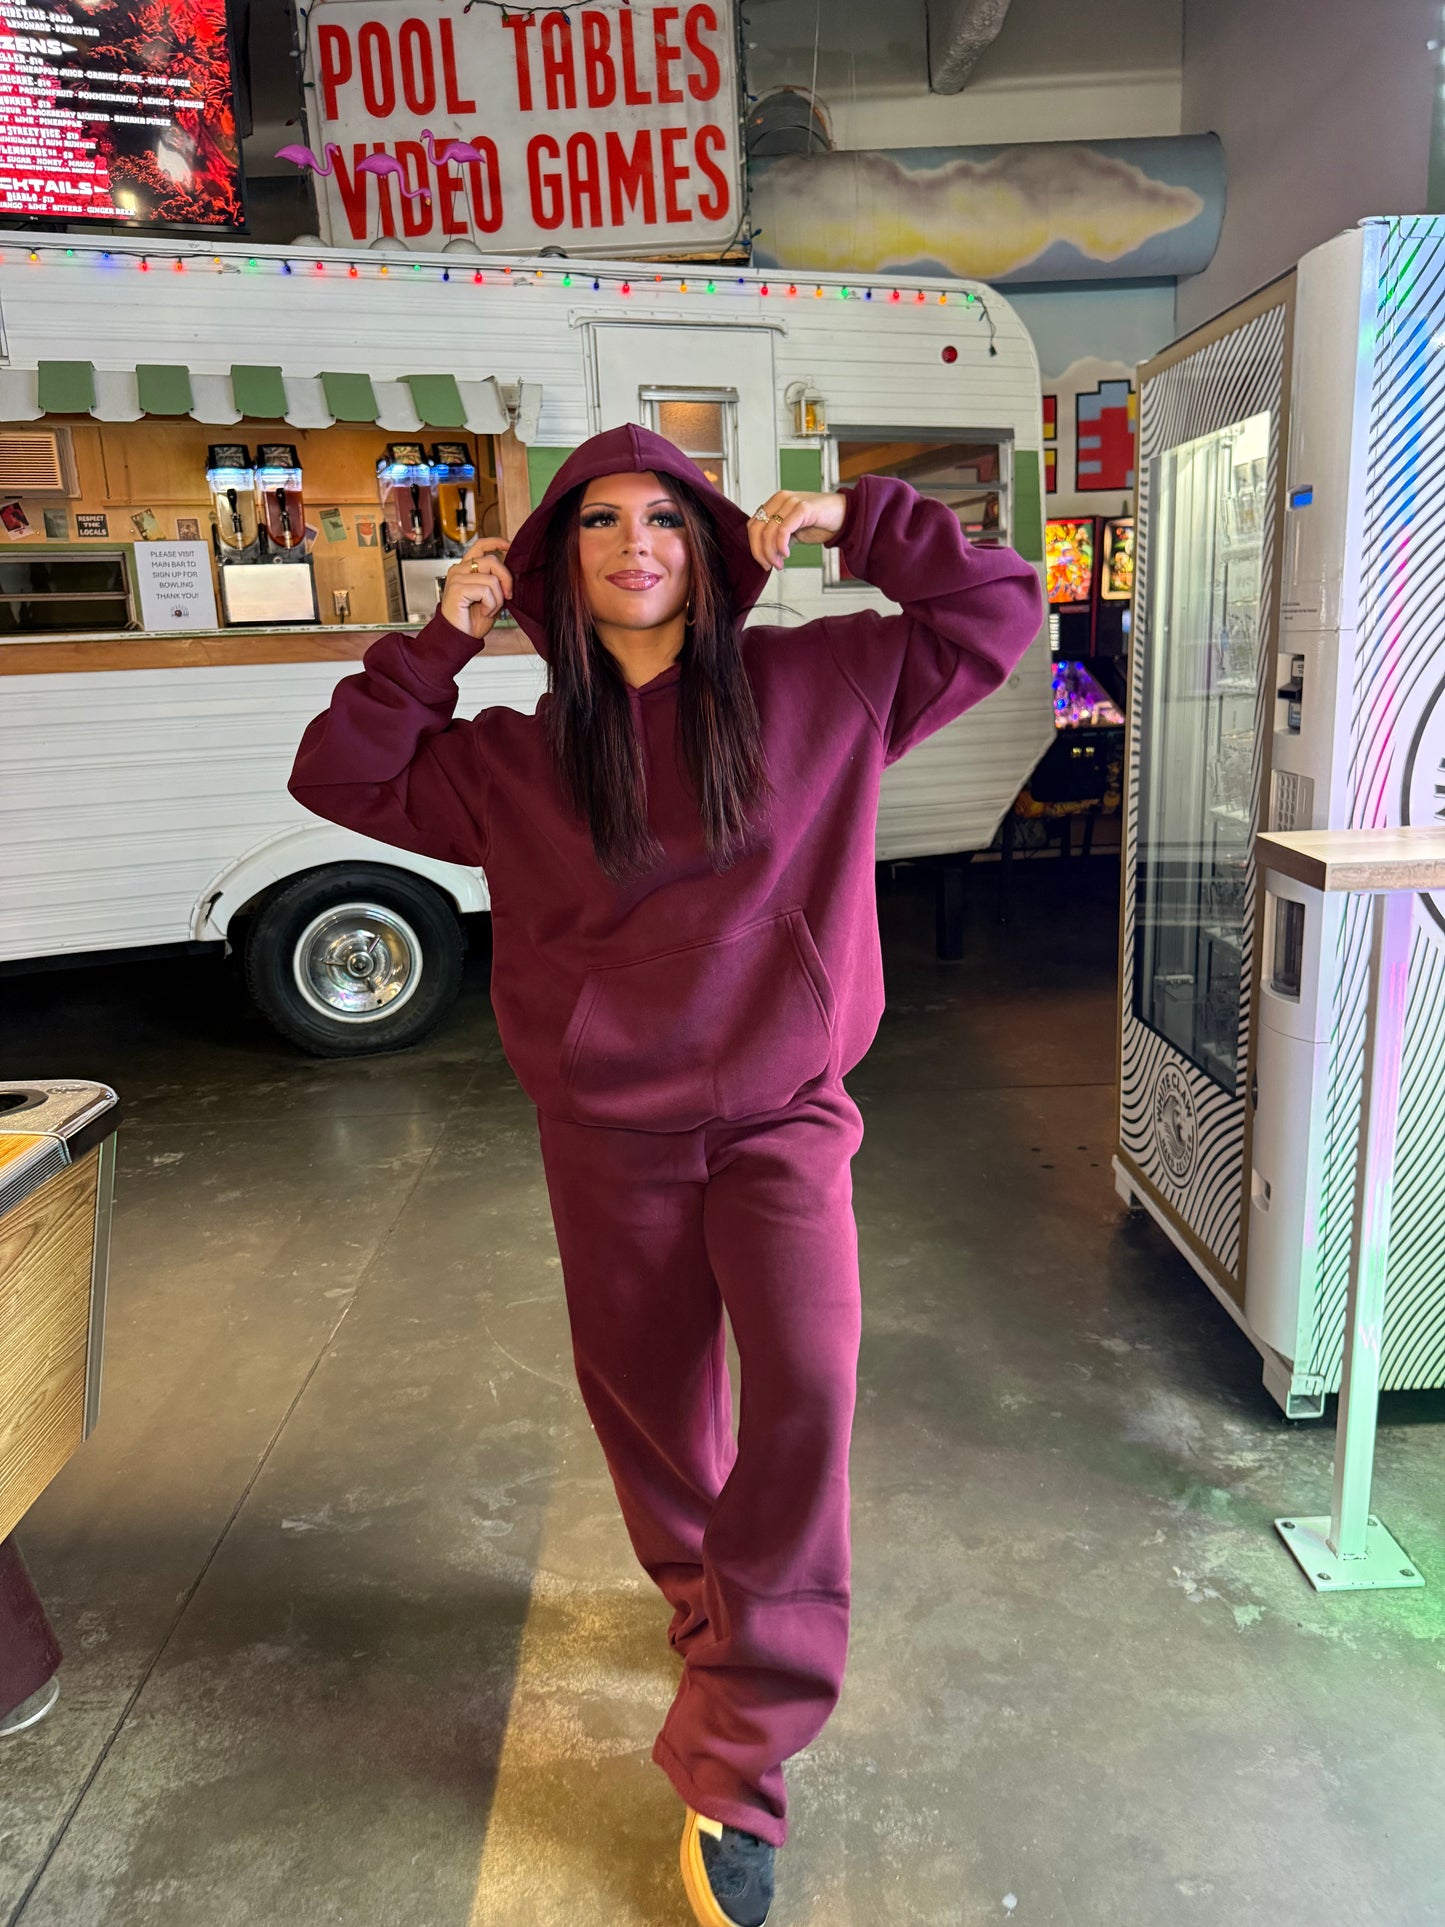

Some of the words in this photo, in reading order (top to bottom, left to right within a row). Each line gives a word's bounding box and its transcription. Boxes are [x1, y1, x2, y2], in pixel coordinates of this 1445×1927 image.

[55, 24, 82, 35] PEACH
[317, 18, 477, 121] POOL
[502, 4, 721, 112] TABLES
[142, 97, 170, 106] LEMON
[174, 100, 204, 109] ORANGE
[26, 108, 76, 118] BLACKBERRY
[77, 112, 110, 121] LIQUEUR
[114, 115, 145, 124] BANANA
[146, 118, 171, 126] PUREE
[39, 118, 82, 128] PINEAPPLE
[7, 125, 39, 136] STREET
[64, 141, 96, 149] RUNNER
[7, 156, 31, 164] SUGAR
[36, 158, 63, 166] HONEY
[333, 136, 503, 241] VIDEO
[526, 124, 730, 230] GAMES
[87, 206, 114, 214] GINGER
[1156, 1072, 1171, 1122] WHITE
[1172, 1072, 1192, 1118] CLAW
